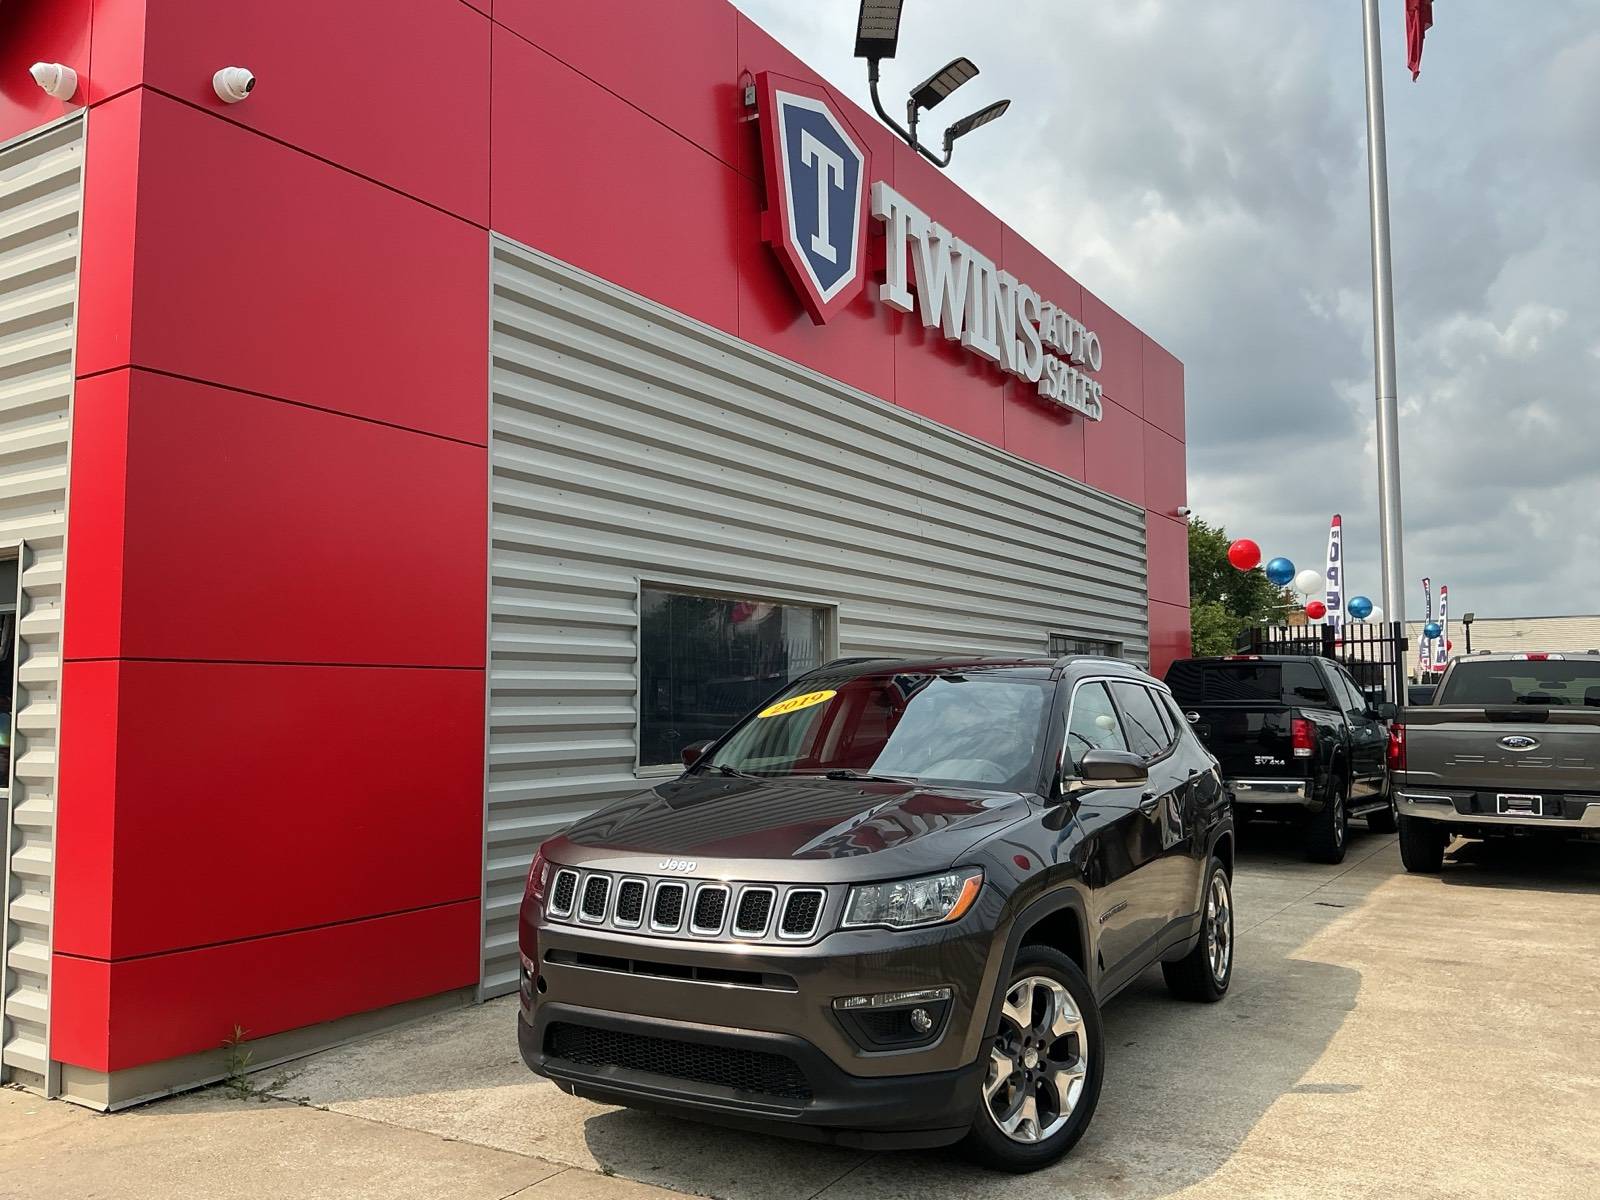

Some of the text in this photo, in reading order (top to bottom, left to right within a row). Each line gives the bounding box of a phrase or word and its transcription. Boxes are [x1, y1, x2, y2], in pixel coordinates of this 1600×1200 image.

[801, 128, 844, 264] T
[872, 181, 1043, 383] TWINS
[1039, 301, 1102, 372] AUTO
[1038, 354, 1103, 421] SALES
[769, 692, 824, 714] 2019
[659, 857, 698, 875] Jeep
